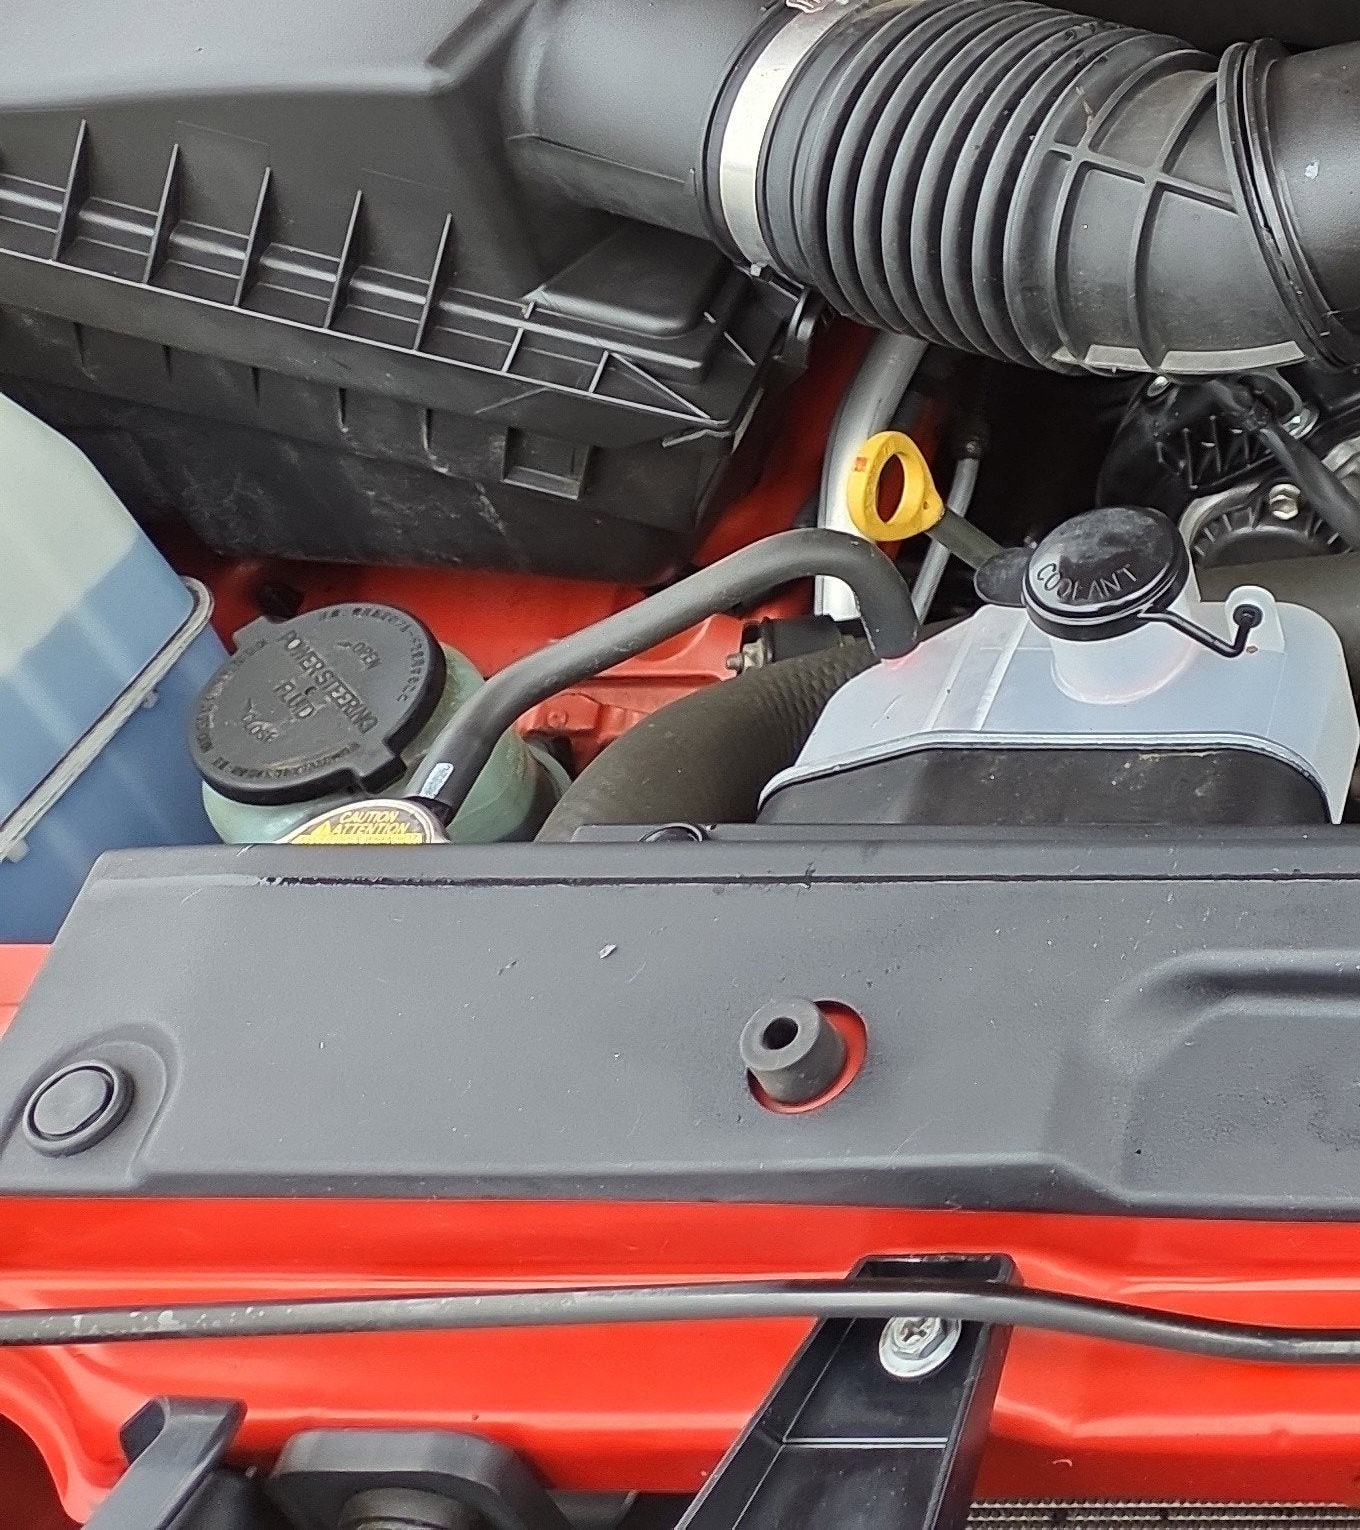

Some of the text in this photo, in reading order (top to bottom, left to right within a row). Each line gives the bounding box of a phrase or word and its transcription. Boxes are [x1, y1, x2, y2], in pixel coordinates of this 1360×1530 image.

[1036, 562, 1137, 601] COOLANT
[273, 681, 315, 719] FLUID
[276, 630, 325, 677] POWER
[316, 669, 379, 734] STEERING
[332, 822, 410, 836] ATTENTION
[339, 810, 399, 824] CAUTION
